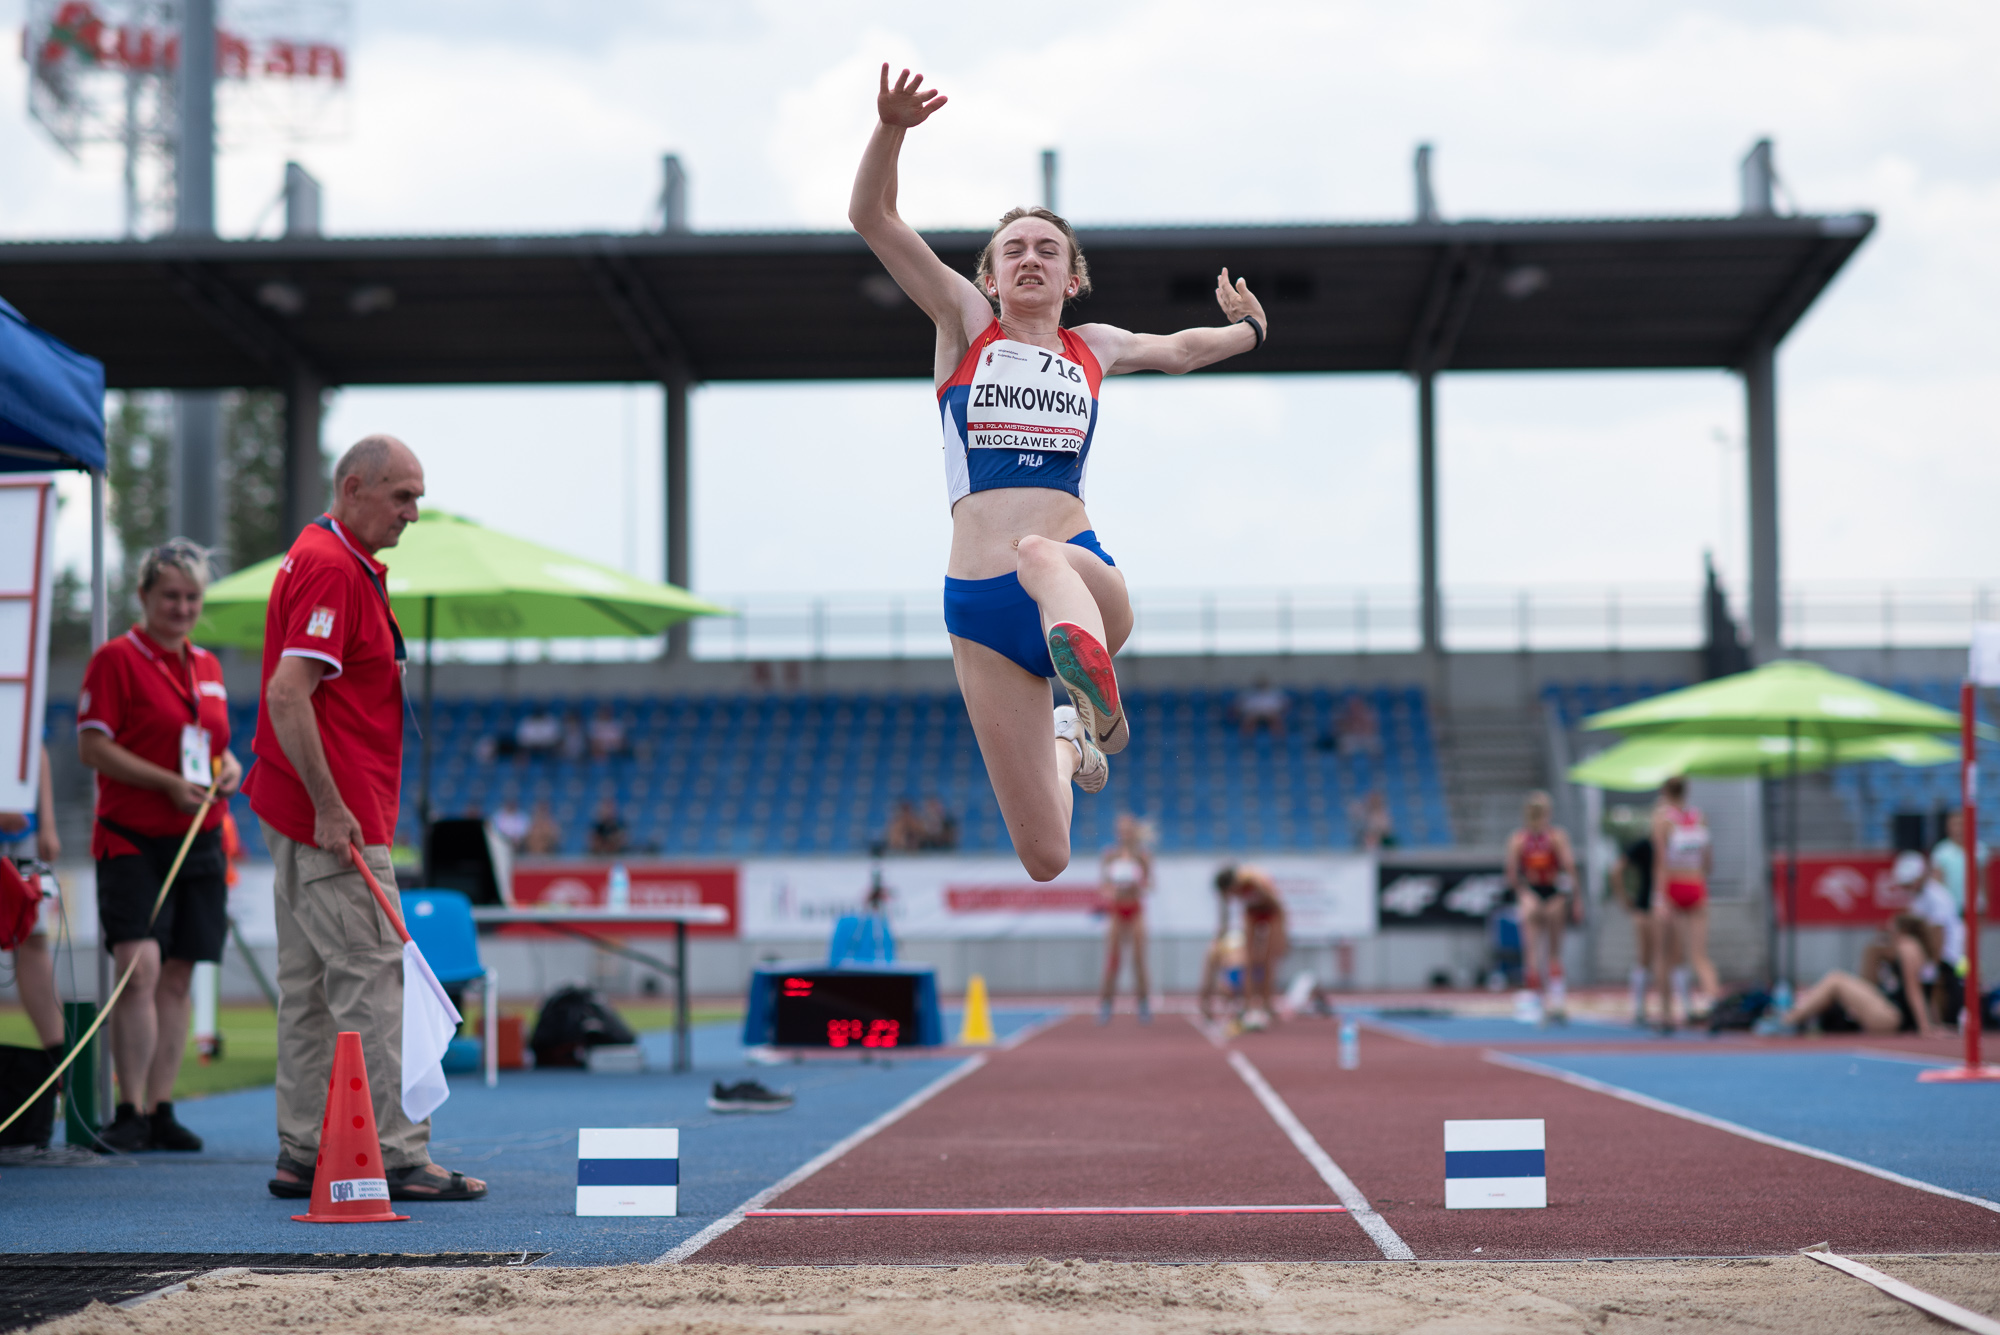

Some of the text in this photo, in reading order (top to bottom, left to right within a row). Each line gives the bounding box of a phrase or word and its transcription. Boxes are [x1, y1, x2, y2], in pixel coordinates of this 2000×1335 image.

[1038, 351, 1081, 383] 716
[973, 384, 1088, 419] ZENKOWSKA
[1004, 424, 1053, 433] MISTRZOSTWA
[975, 434, 1083, 450] WŁOCŁAWEK 202
[1018, 453, 1044, 467] PIŁA
